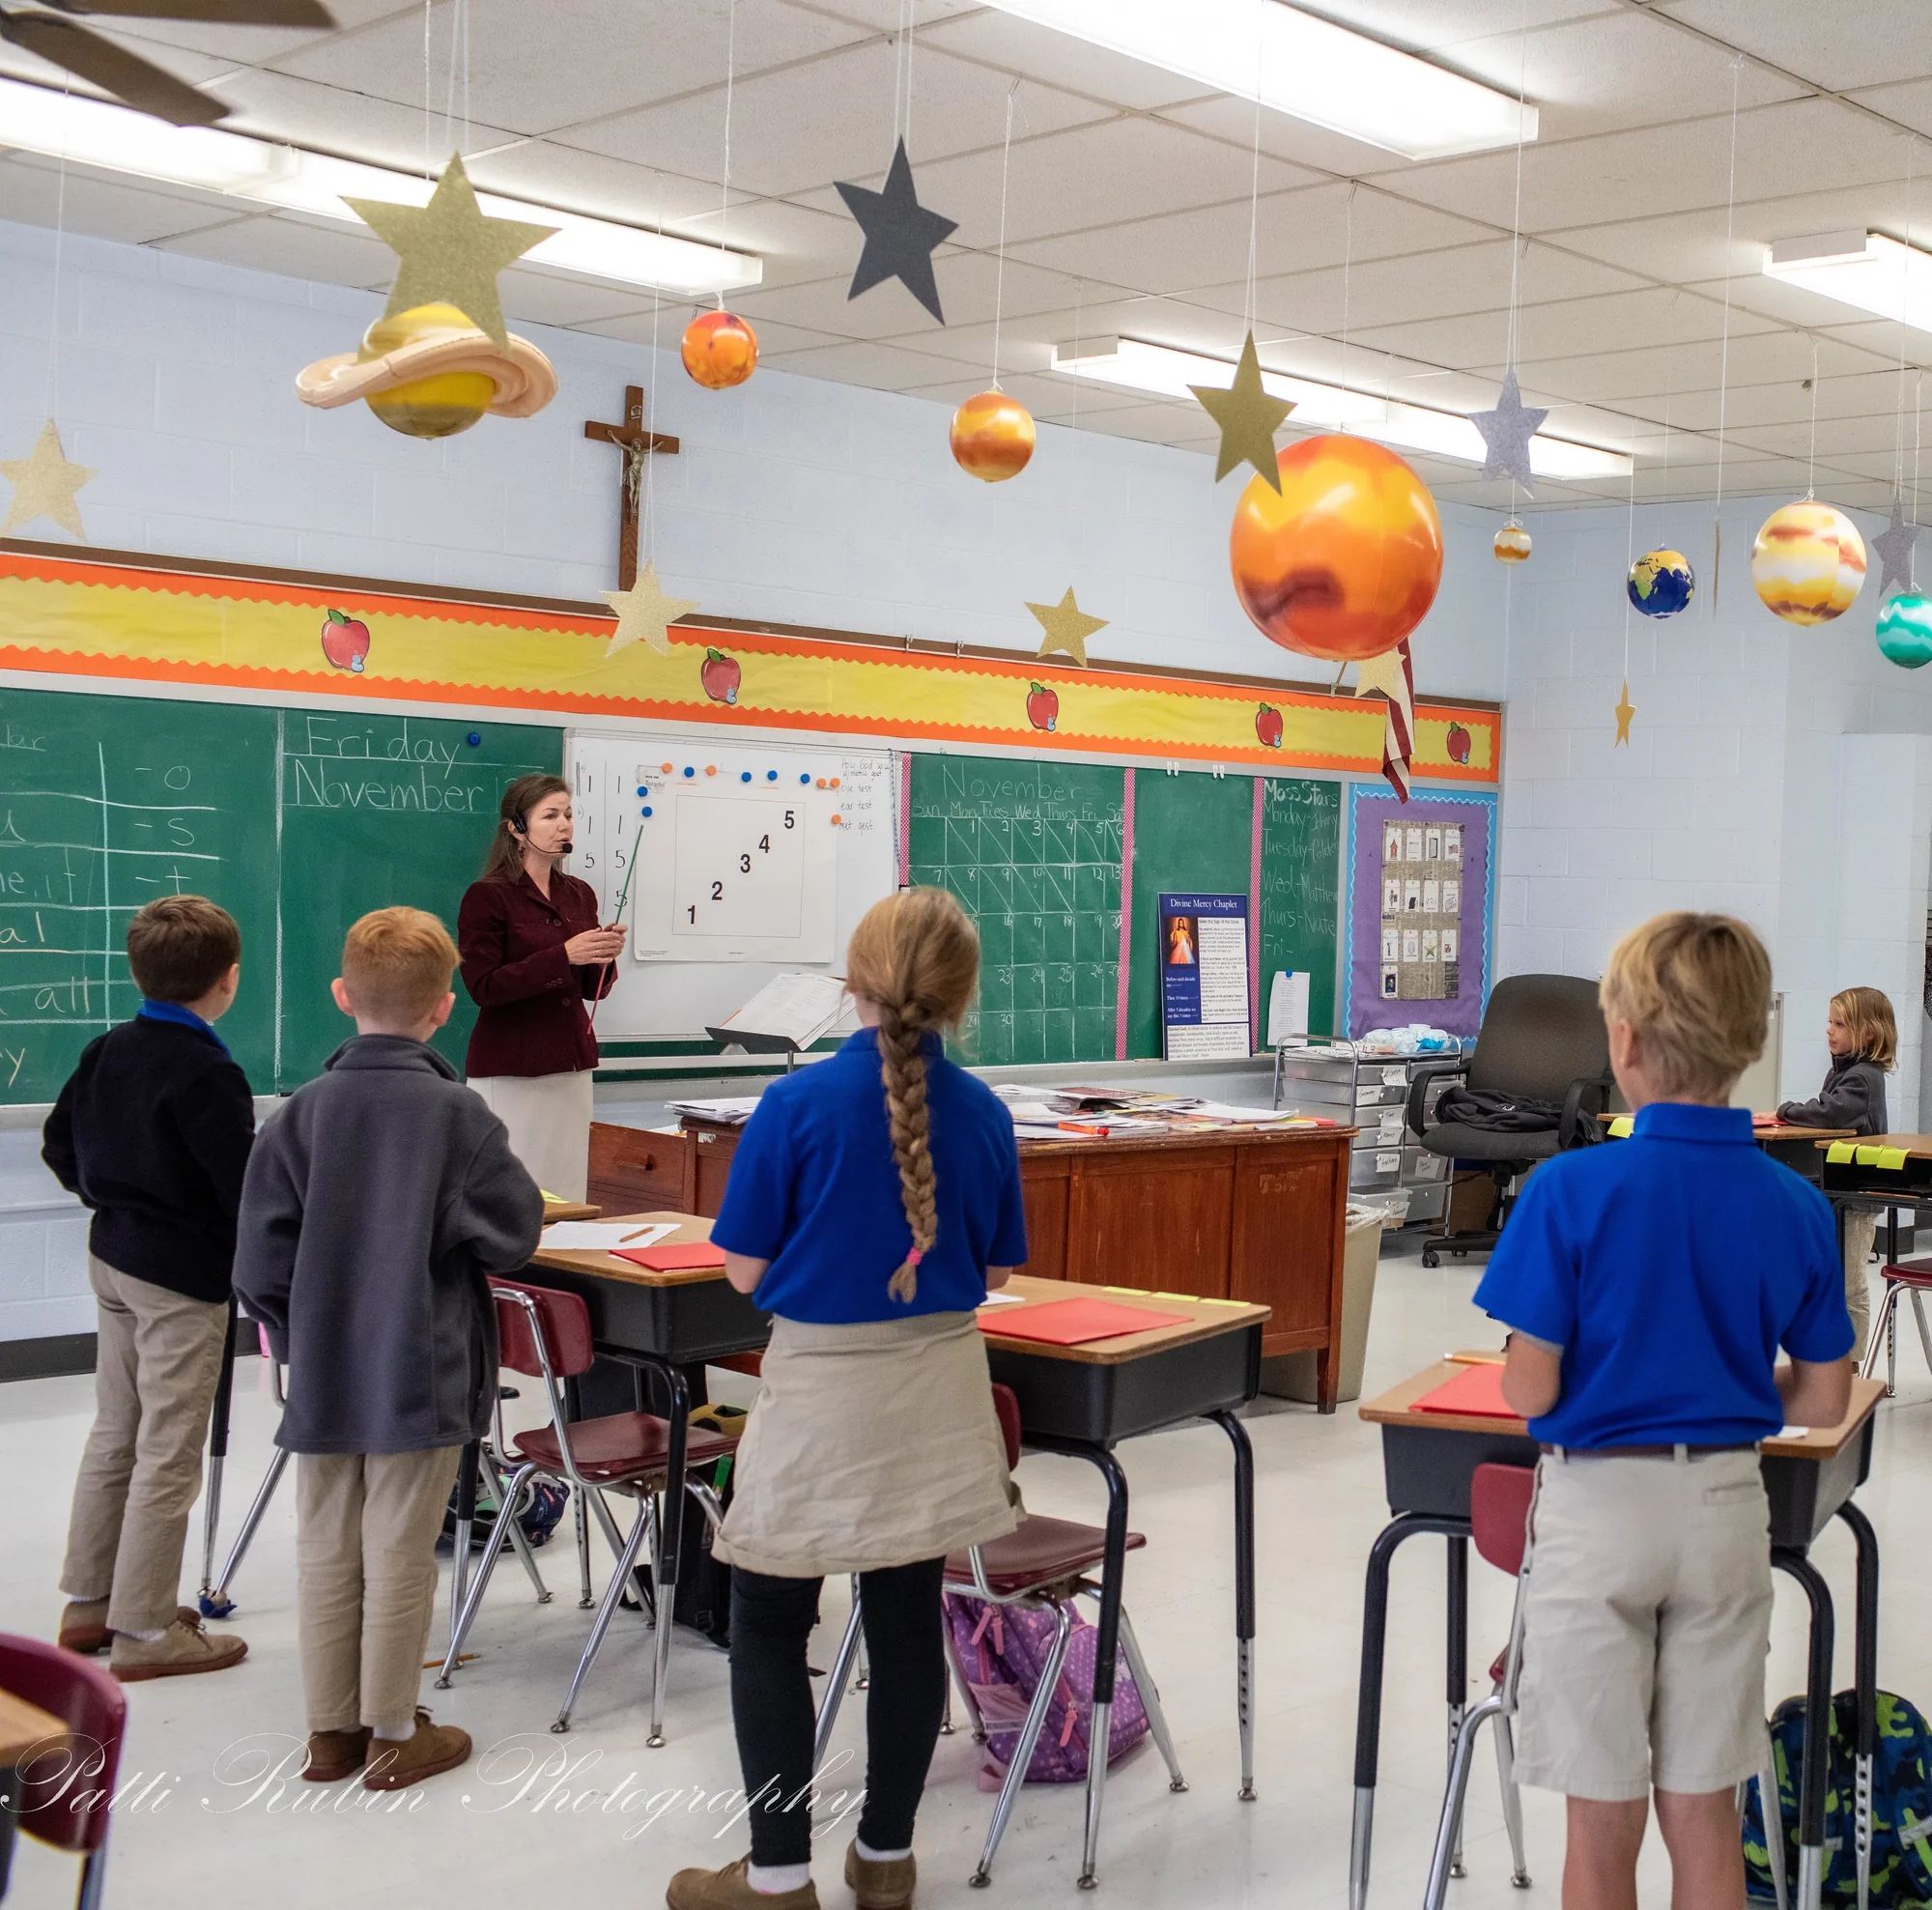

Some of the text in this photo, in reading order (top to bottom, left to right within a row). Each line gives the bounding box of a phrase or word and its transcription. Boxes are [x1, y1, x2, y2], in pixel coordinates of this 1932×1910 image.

[306, 716, 460, 780] Friday
[295, 757, 484, 812] November
[942, 761, 1083, 801] November
[1301, 781, 1339, 808] Stars
[784, 810, 795, 830] 5
[969, 819, 1123, 837] 1 2 3 4 5 6
[758, 834, 770, 853] 4
[584, 851, 595, 869] 5
[614, 848, 626, 869] 5
[740, 853, 751, 873] 3
[933, 865, 1122, 882] 7 8 9 10 11 12 13
[614, 889, 628, 908] 5
[711, 881, 723, 900] 2
[687, 904, 696, 925] 1
[1170, 898, 1237, 911] Divine Mercy Chaplet
[1034, 917, 1041, 927] 17
[1064, 915, 1073, 927] 18
[998, 967, 1012, 984] 23
[1030, 967, 1043, 984] 24
[1058, 965, 1072, 984] 25
[1091, 964, 1103, 978] 26
[35, 976, 90, 1013] all
[1000, 1013, 1012, 1028] 30
